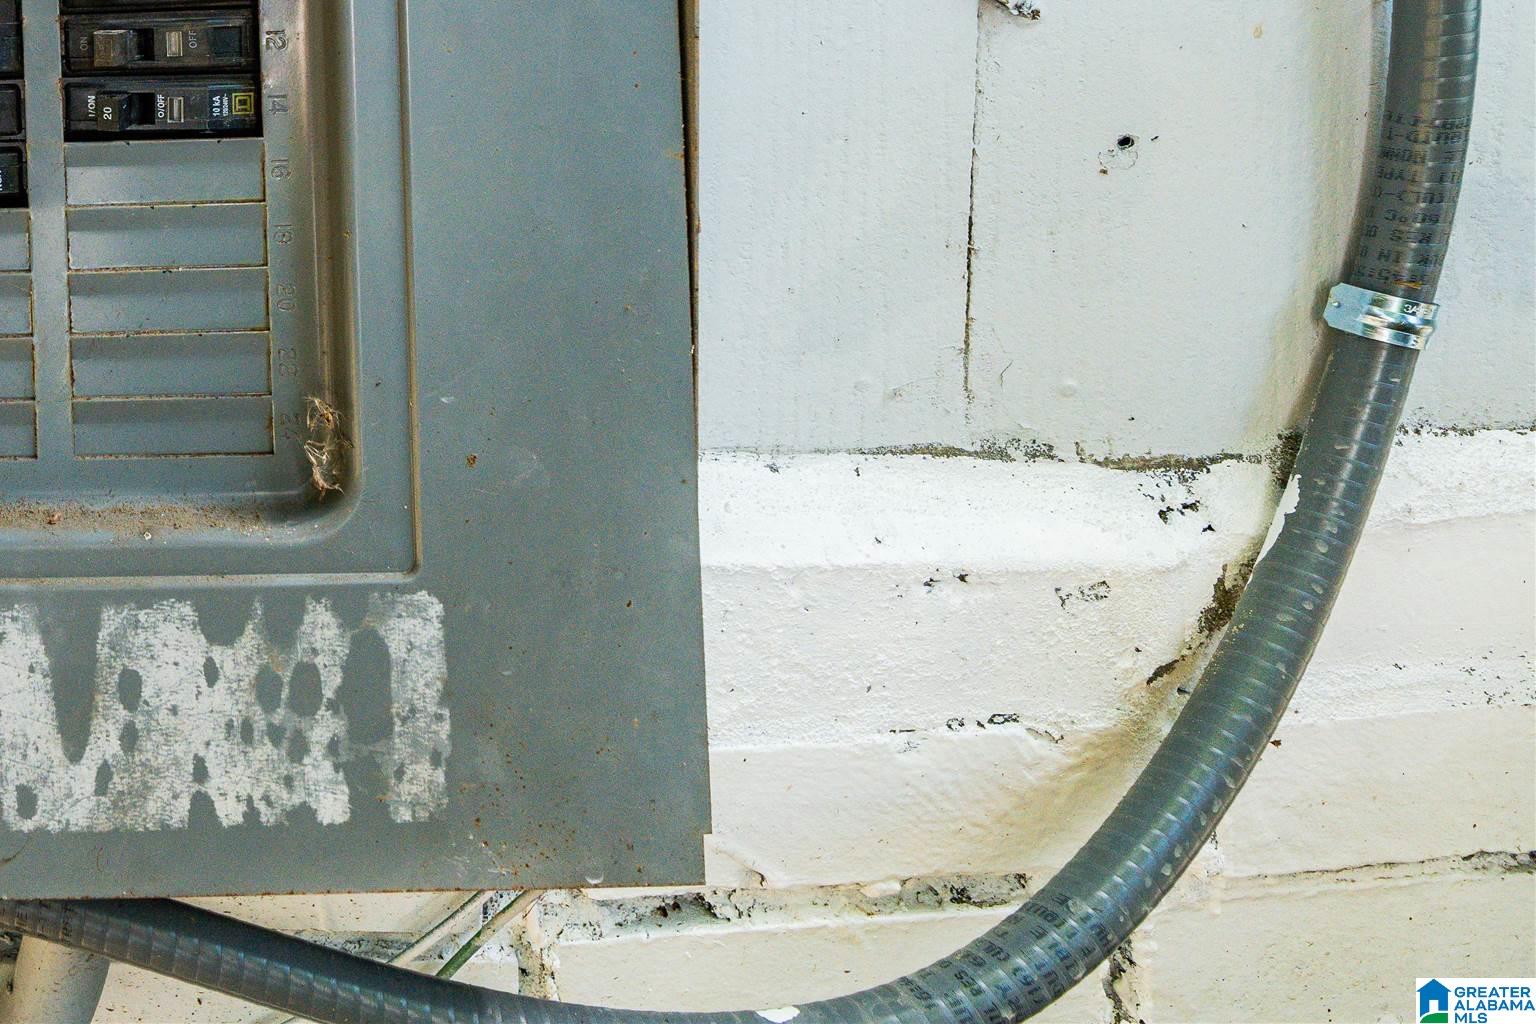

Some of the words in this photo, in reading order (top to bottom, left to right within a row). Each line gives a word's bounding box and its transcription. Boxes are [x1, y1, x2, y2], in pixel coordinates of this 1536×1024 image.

[80, 36, 88, 51] ON
[189, 30, 198, 49] OFF
[103, 107, 112, 120] 20
